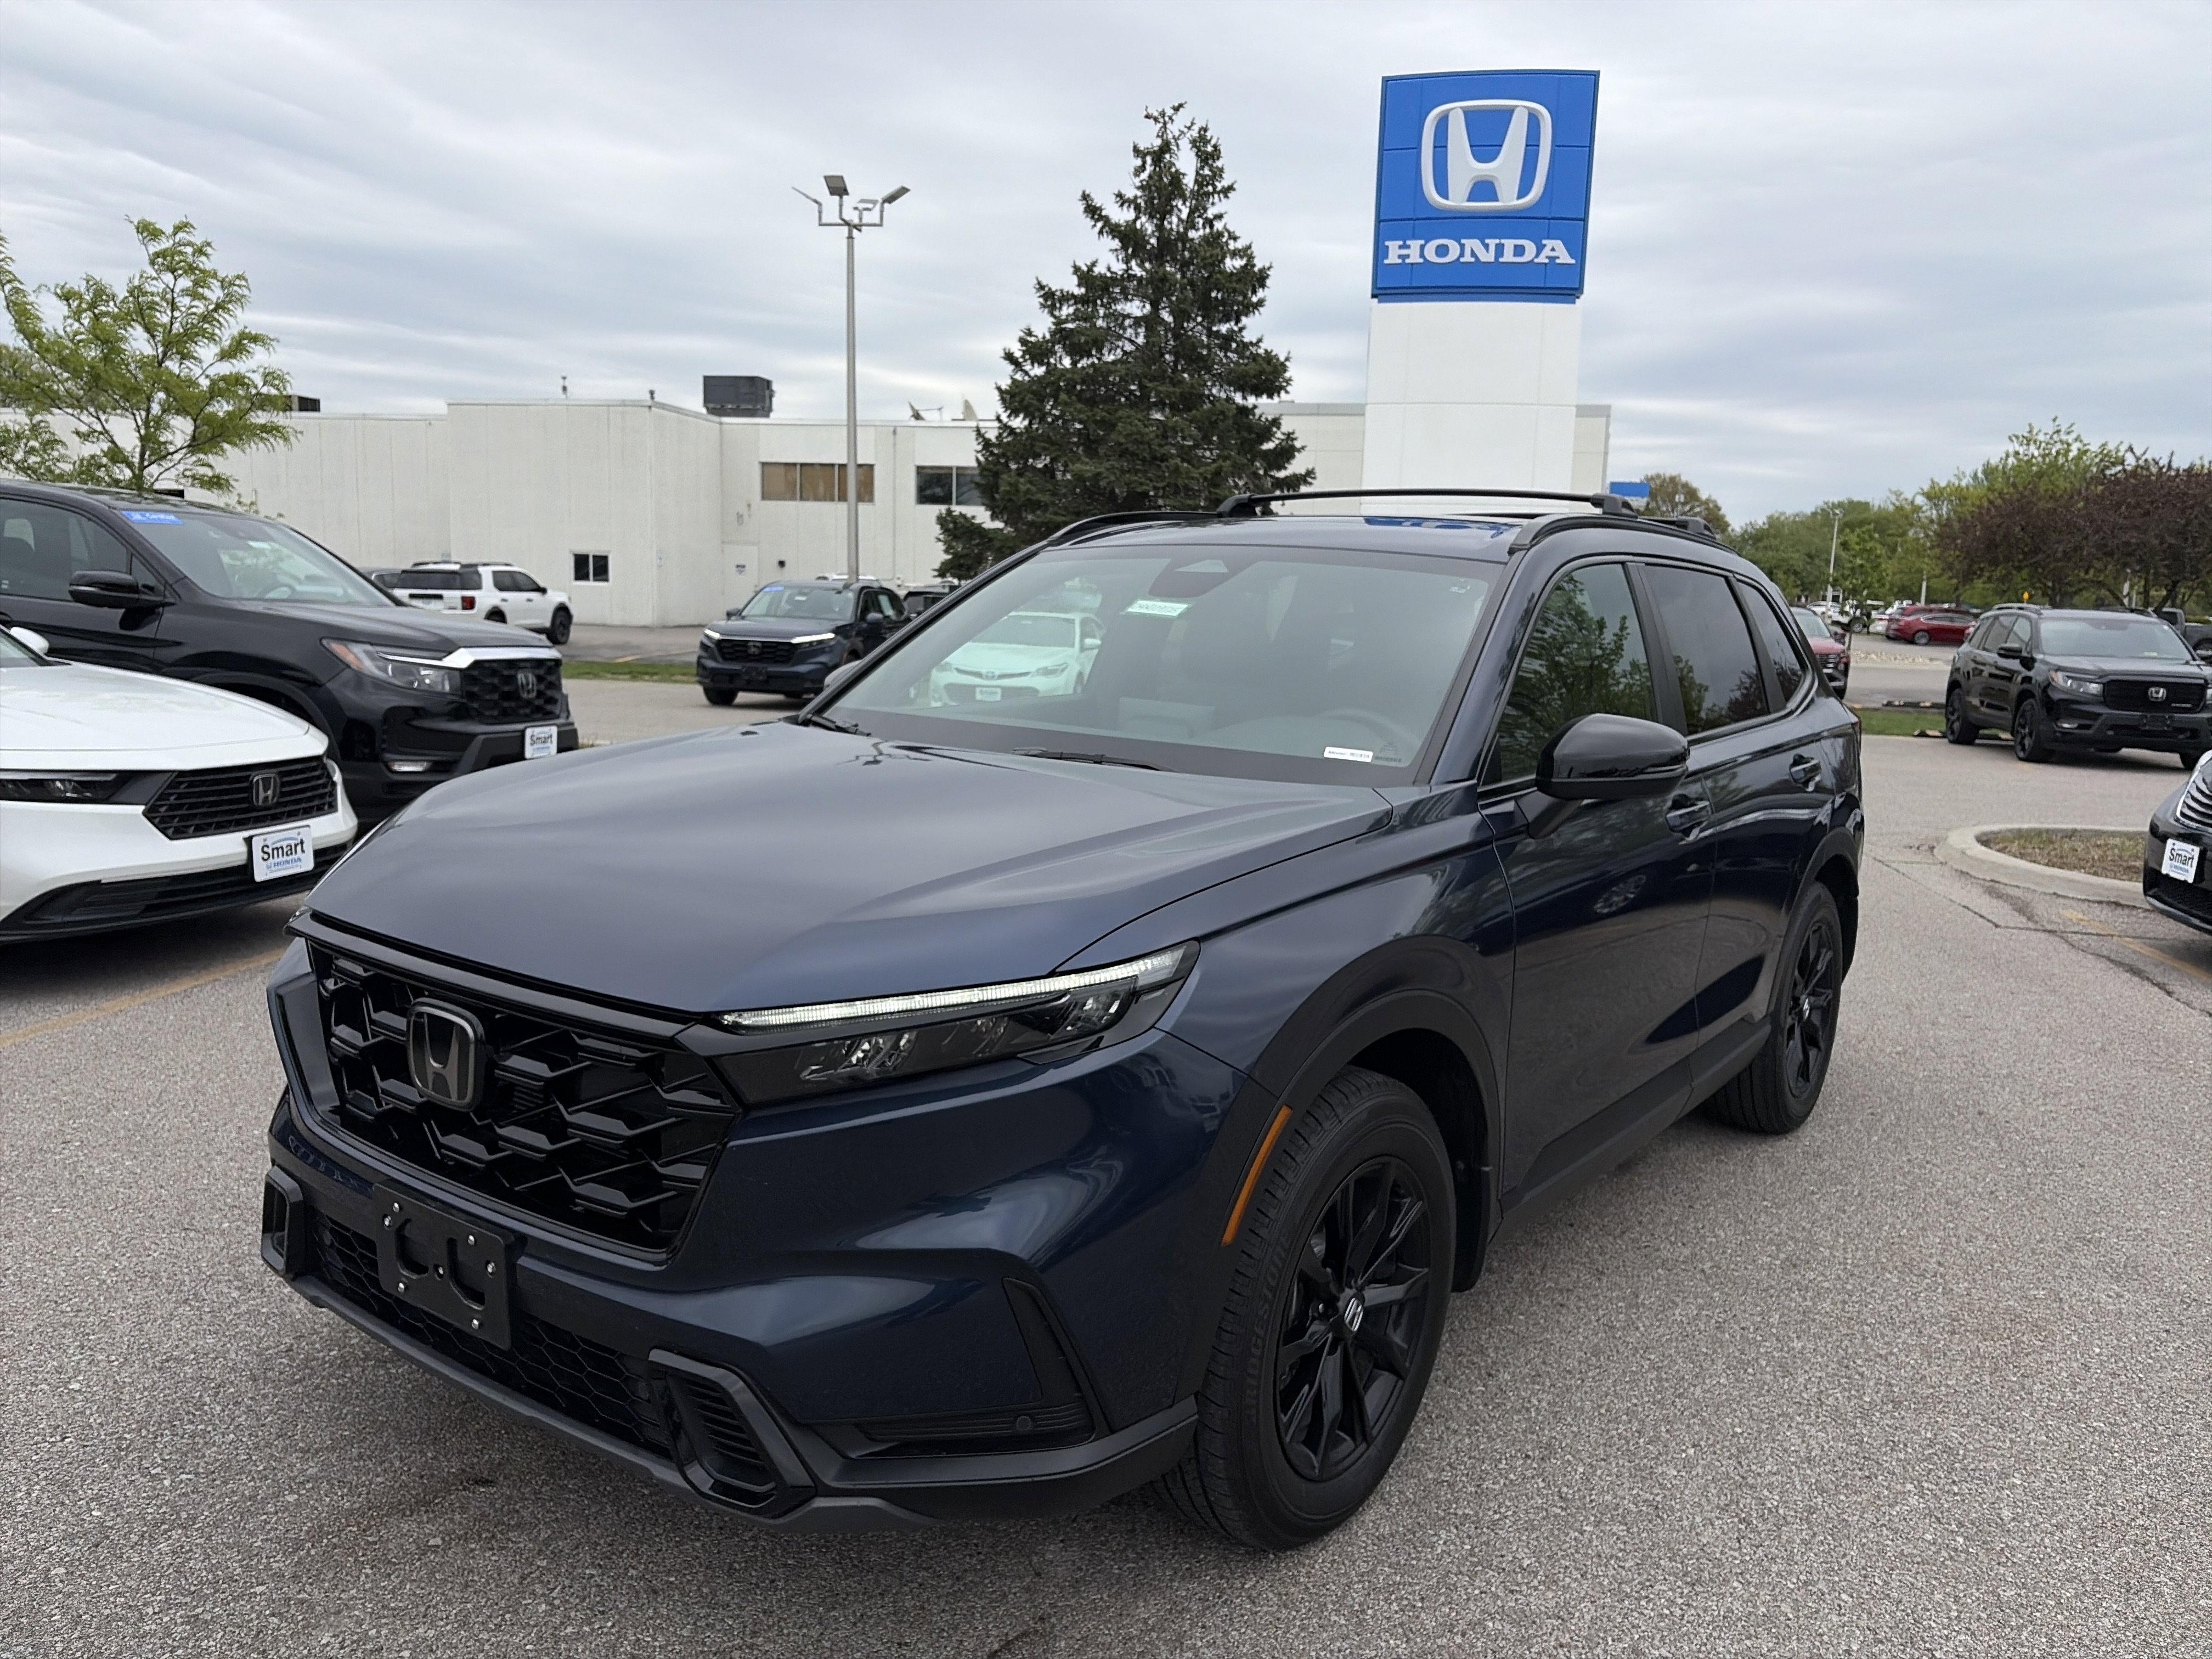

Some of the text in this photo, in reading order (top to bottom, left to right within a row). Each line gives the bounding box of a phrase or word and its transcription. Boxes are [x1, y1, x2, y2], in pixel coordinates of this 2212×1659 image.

[1384, 238, 1576, 266] HONDA
[530, 733, 553, 747] Smart
[261, 838, 306, 861] Smart
[2169, 848, 2194, 868] Smart
[273, 856, 302, 868] HONDA
